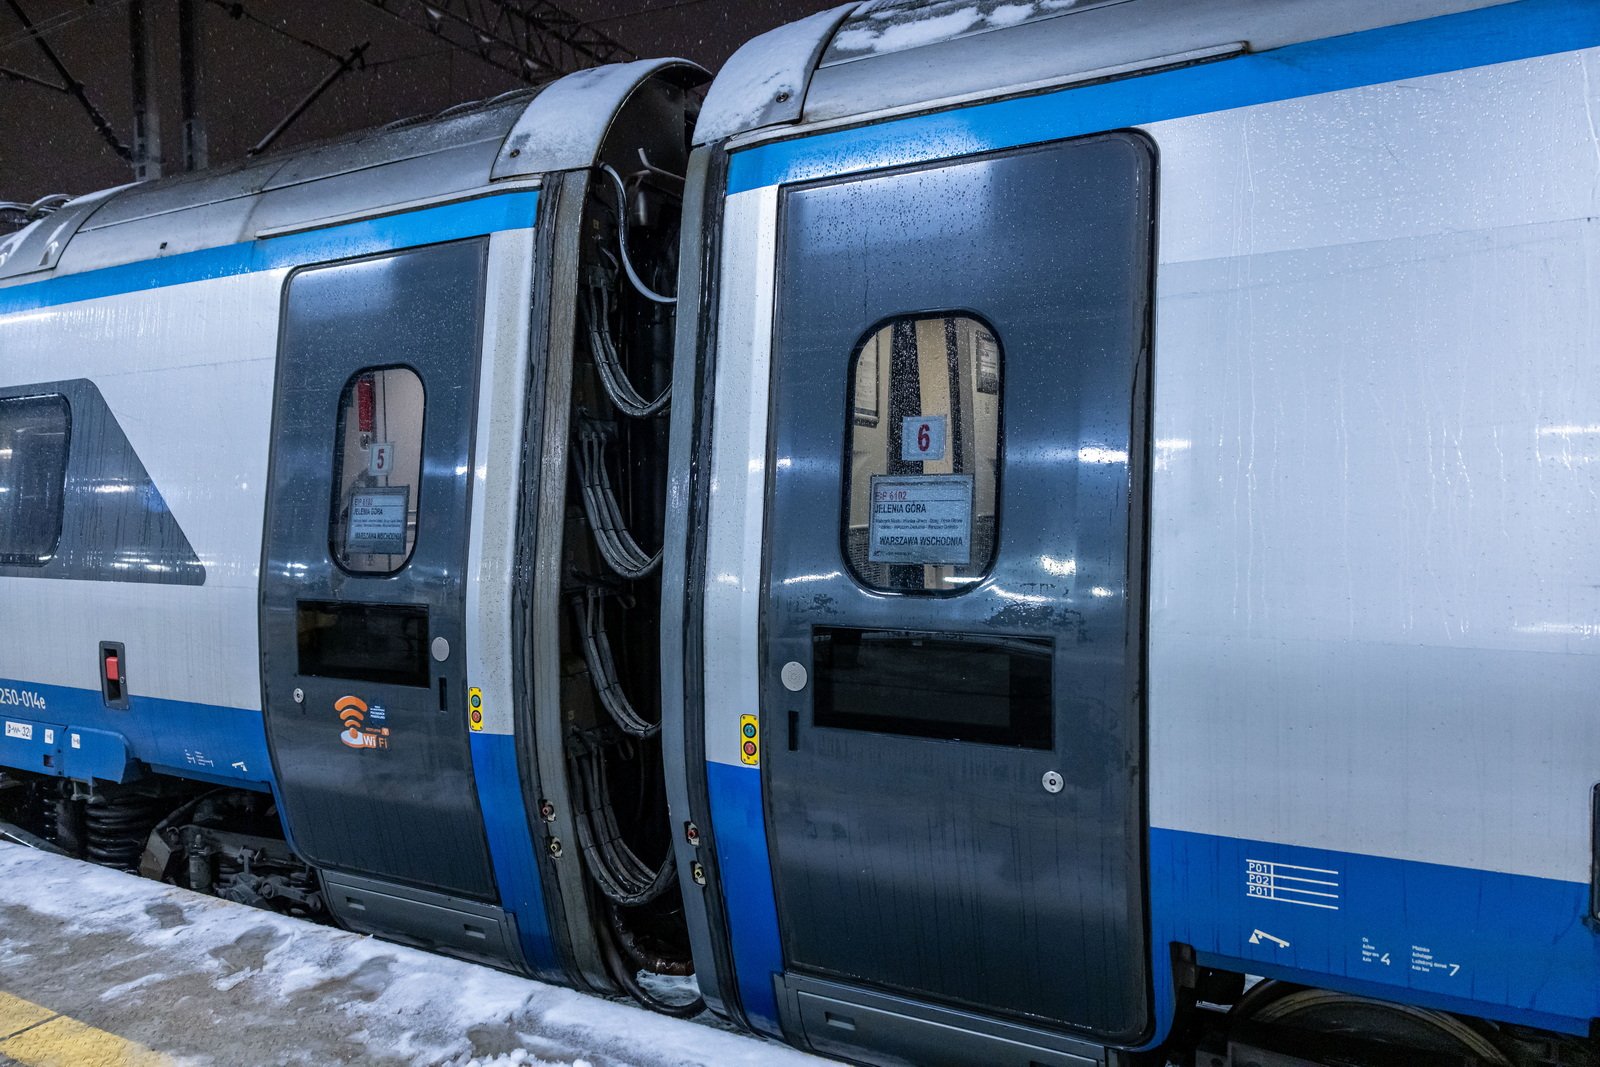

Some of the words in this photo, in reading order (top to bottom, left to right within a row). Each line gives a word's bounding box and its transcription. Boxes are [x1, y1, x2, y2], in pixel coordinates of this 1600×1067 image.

[917, 424, 930, 452] 6
[376, 448, 385, 469] 5
[875, 504, 903, 514] JELENIA
[905, 501, 927, 514] GÓRA
[879, 536, 918, 546] WARSZAWA
[920, 536, 963, 546] WSCHODNIA
[1248, 862, 1268, 874] P01
[1249, 874, 1269, 886] P02
[1249, 885, 1268, 897] P01
[1380, 952, 1391, 966] 4
[1448, 963, 1460, 977] 7
